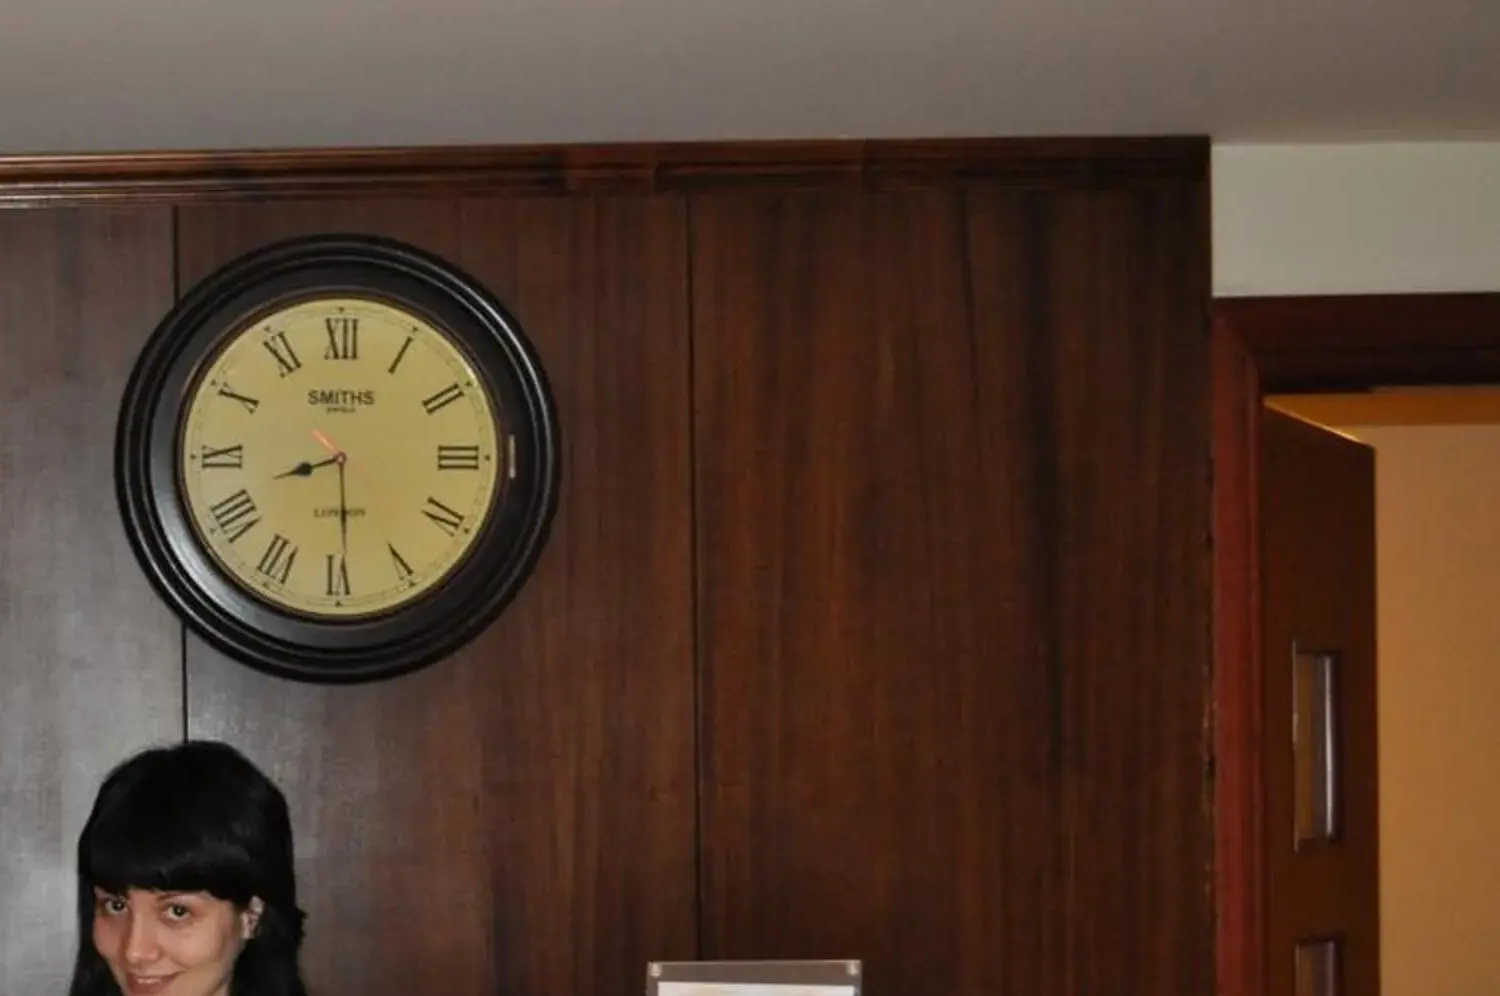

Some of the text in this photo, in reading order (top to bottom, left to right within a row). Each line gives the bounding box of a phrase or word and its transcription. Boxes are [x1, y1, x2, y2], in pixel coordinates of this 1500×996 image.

[262, 331, 302, 379] XI
[324, 317, 360, 360] XII
[388, 335, 414, 375] I
[218, 381, 260, 415] X
[307, 390, 376, 406] SMITHS
[421, 382, 465, 415] II
[201, 444, 243, 470] IX
[437, 444, 480, 471] III
[209, 488, 263, 544] VIII
[313, 507, 367, 519] LONON
[421, 496, 465, 538] IV
[255, 533, 299, 585] VII
[326, 554, 351, 596] VI
[387, 540, 414, 582] V
